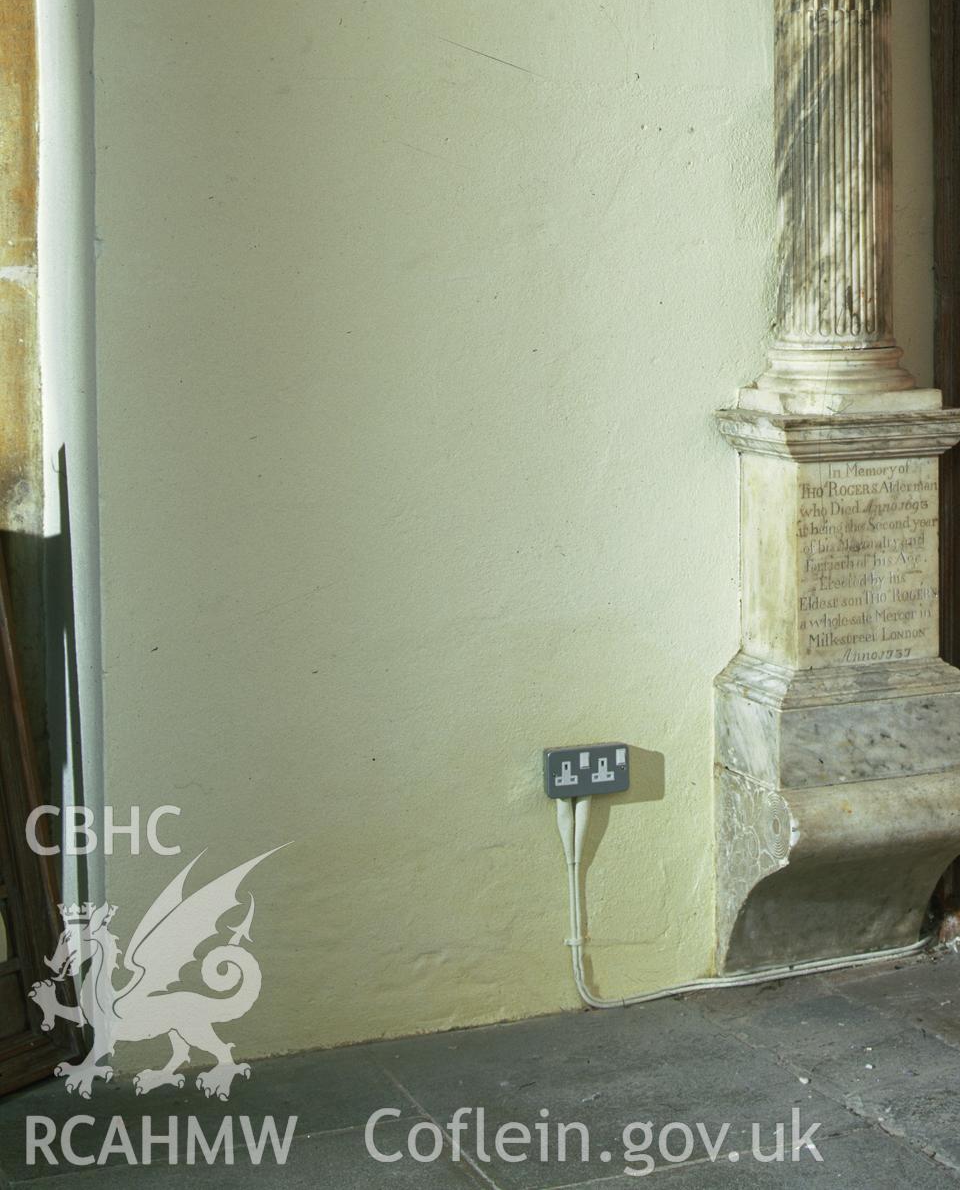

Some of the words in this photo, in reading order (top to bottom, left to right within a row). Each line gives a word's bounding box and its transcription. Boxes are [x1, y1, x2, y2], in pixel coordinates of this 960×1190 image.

[829, 462, 841, 479] In
[846, 462, 897, 480] Memory
[898, 459, 912, 474] of
[879, 480, 938, 494] Alderman
[800, 503, 827, 518] who
[831, 500, 860, 516] Died
[810, 519, 843, 539] being
[868, 514, 911, 531] Second
[912, 518, 938, 533] year
[803, 538, 817, 554] of
[873, 552, 894, 567] his
[870, 571, 884, 588] by
[889, 570, 906, 584] his
[799, 596, 838, 611] Eldest
[841, 595, 862, 607] son
[800, 619, 807, 631] a
[875, 609, 916, 623] Mercer
[919, 608, 932, 619] in
